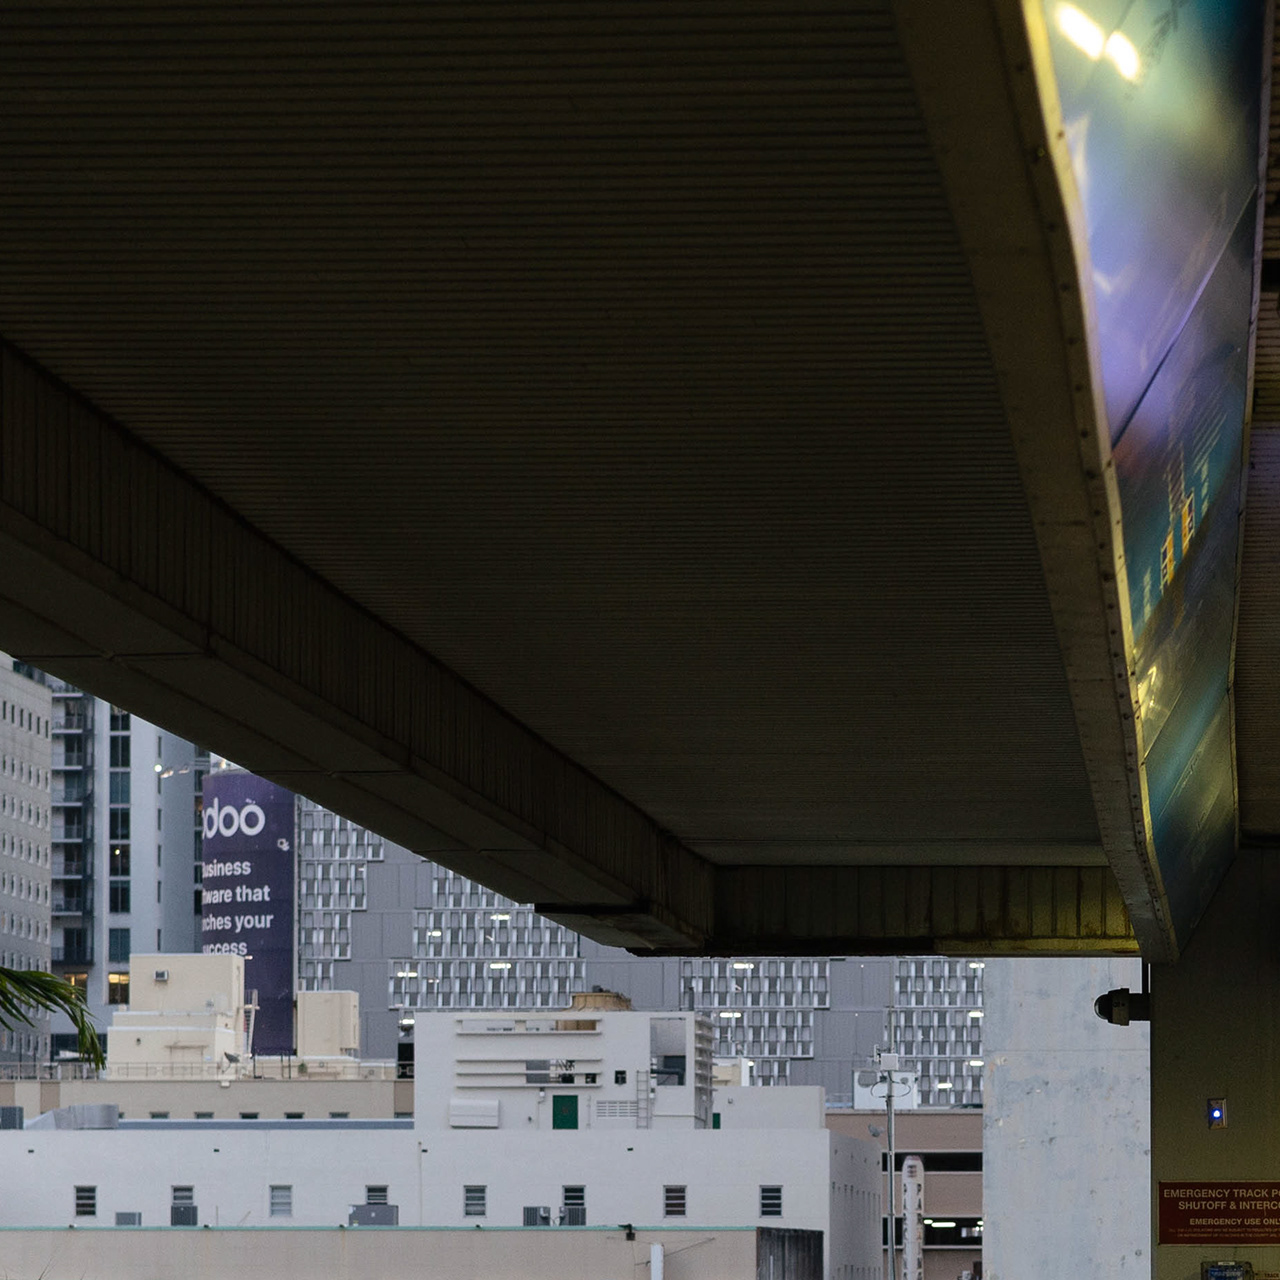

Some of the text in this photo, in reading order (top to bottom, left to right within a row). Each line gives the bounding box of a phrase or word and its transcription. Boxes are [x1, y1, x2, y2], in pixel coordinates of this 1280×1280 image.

[202, 797, 265, 839] doo
[235, 884, 271, 902] that
[235, 914, 274, 933] your
[1163, 1189, 1230, 1198] EMERGENCY
[1233, 1189, 1269, 1198] TRACK
[1178, 1201, 1227, 1210] SHUTOFF
[1229, 1201, 1236, 1210] &
[1189, 1218, 1242, 1226] EMERGENCY
[1244, 1218, 1261, 1226] USE
